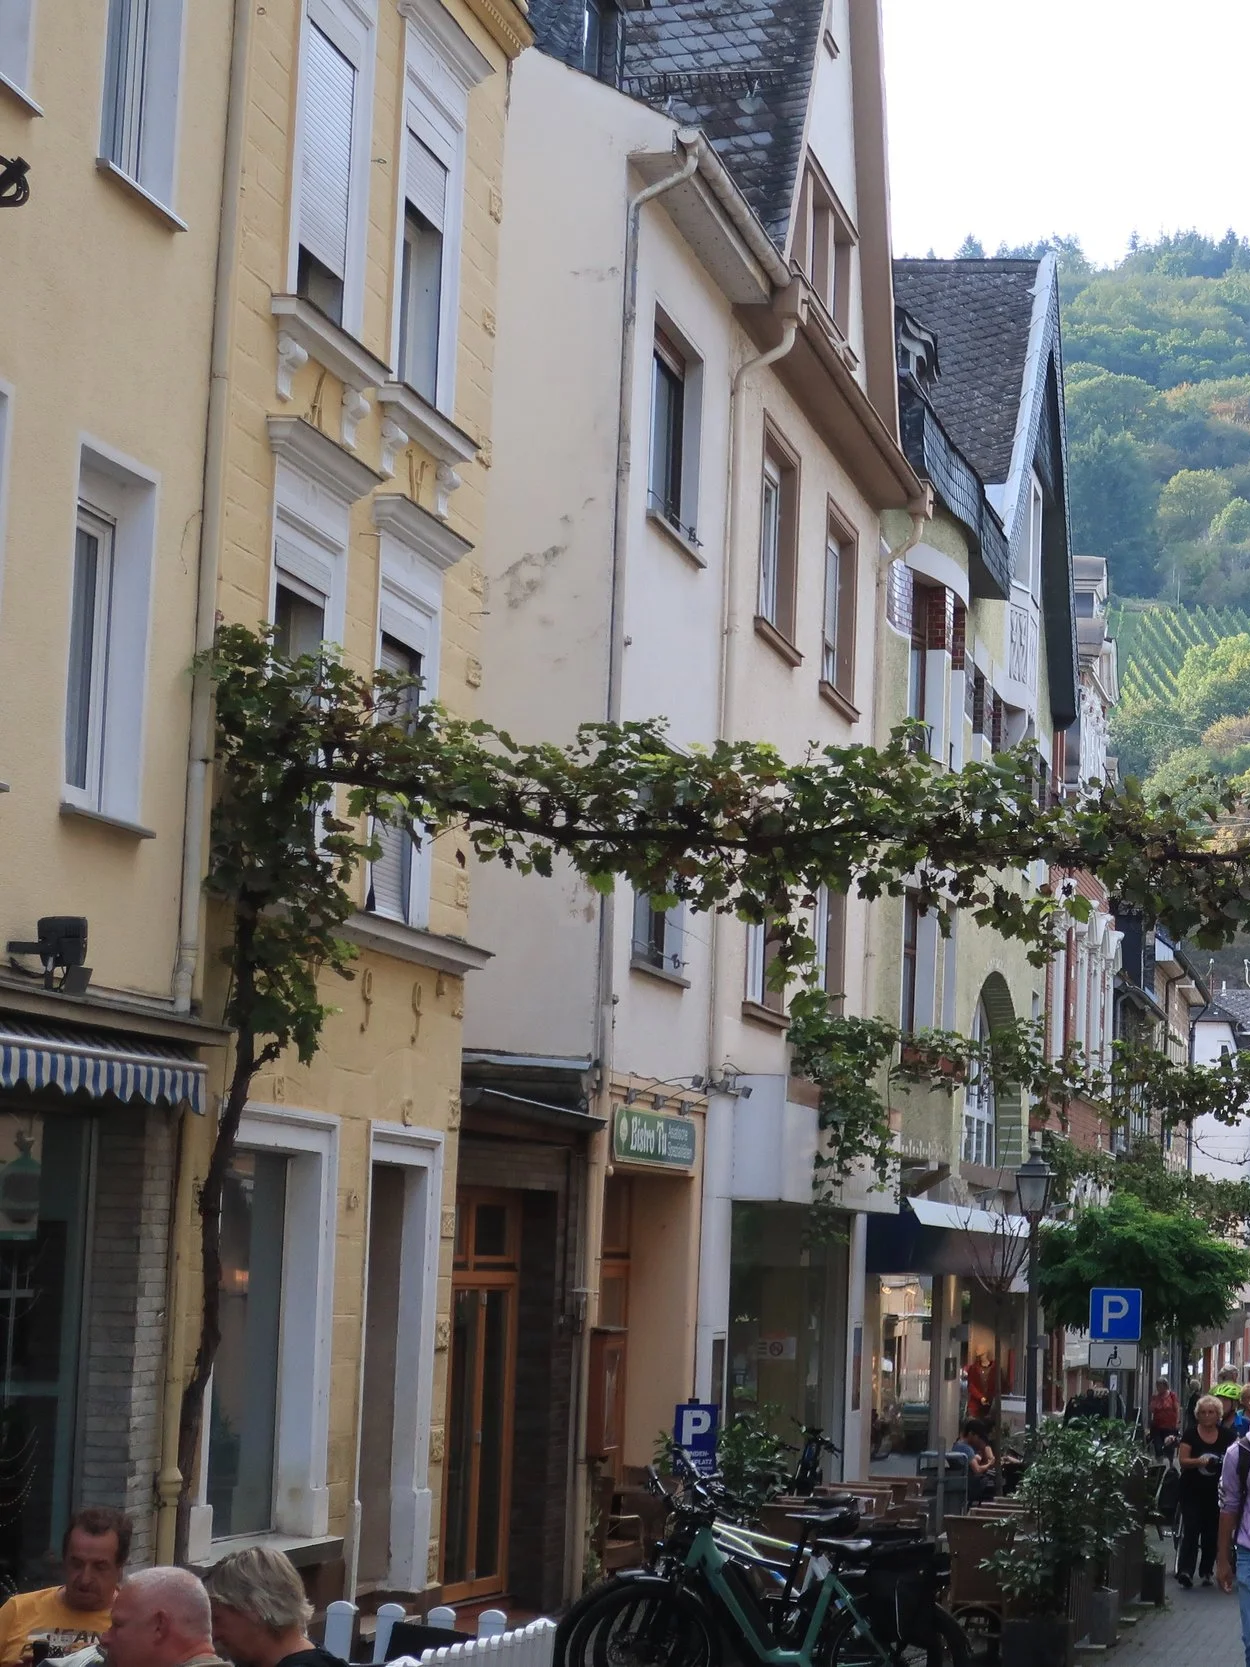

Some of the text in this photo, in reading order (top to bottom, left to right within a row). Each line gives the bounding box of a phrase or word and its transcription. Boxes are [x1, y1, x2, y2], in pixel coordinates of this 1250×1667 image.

[630, 1115, 655, 1155] Bistro
[1102, 1295, 1129, 1333] P
[681, 1409, 711, 1445] P
